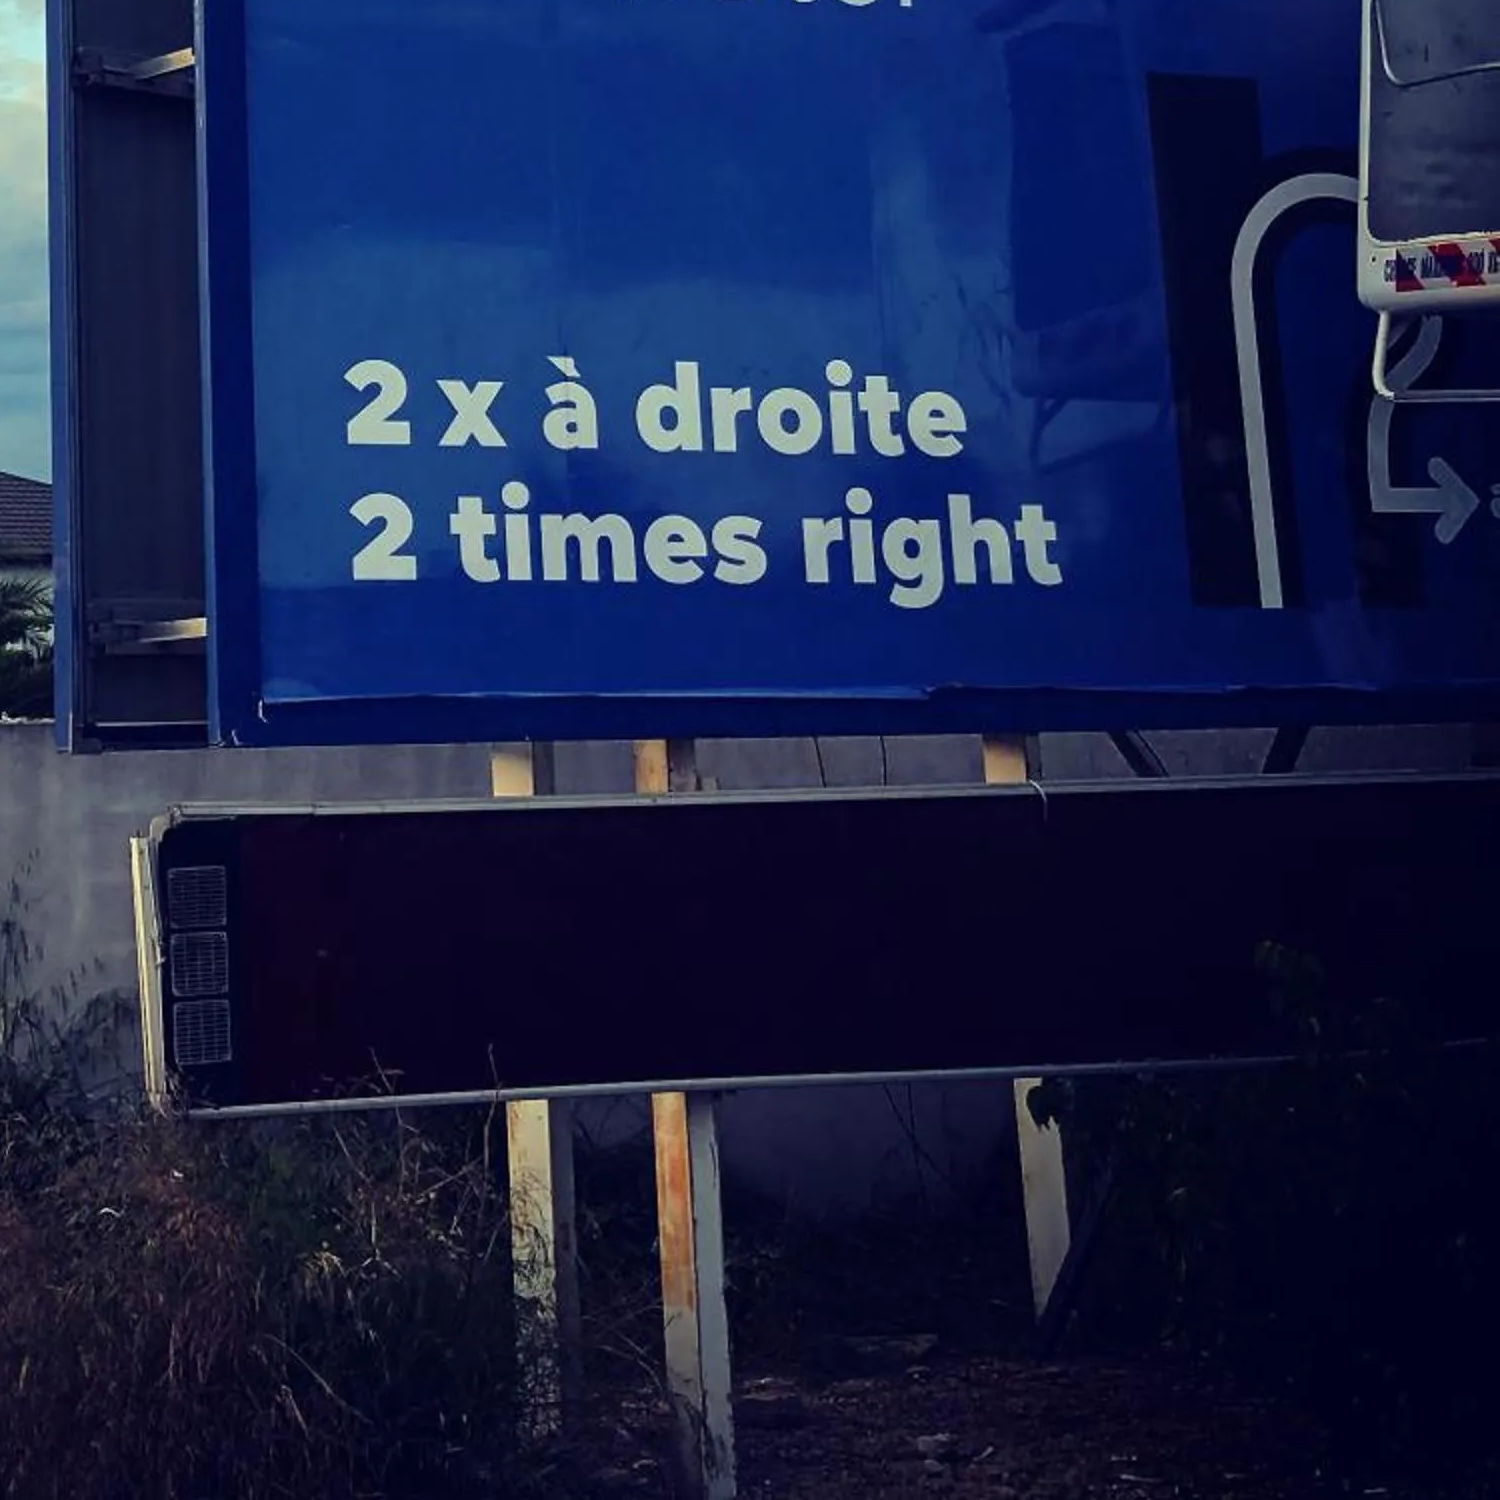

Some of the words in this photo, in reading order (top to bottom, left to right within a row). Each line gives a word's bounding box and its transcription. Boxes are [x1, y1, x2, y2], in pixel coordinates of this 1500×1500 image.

[343, 359, 411, 445] 2
[436, 379, 507, 447] x
[542, 355, 599, 450] à
[635, 359, 967, 457] droite
[349, 492, 417, 581] 2
[449, 481, 767, 585] times
[802, 487, 1063, 609] right
